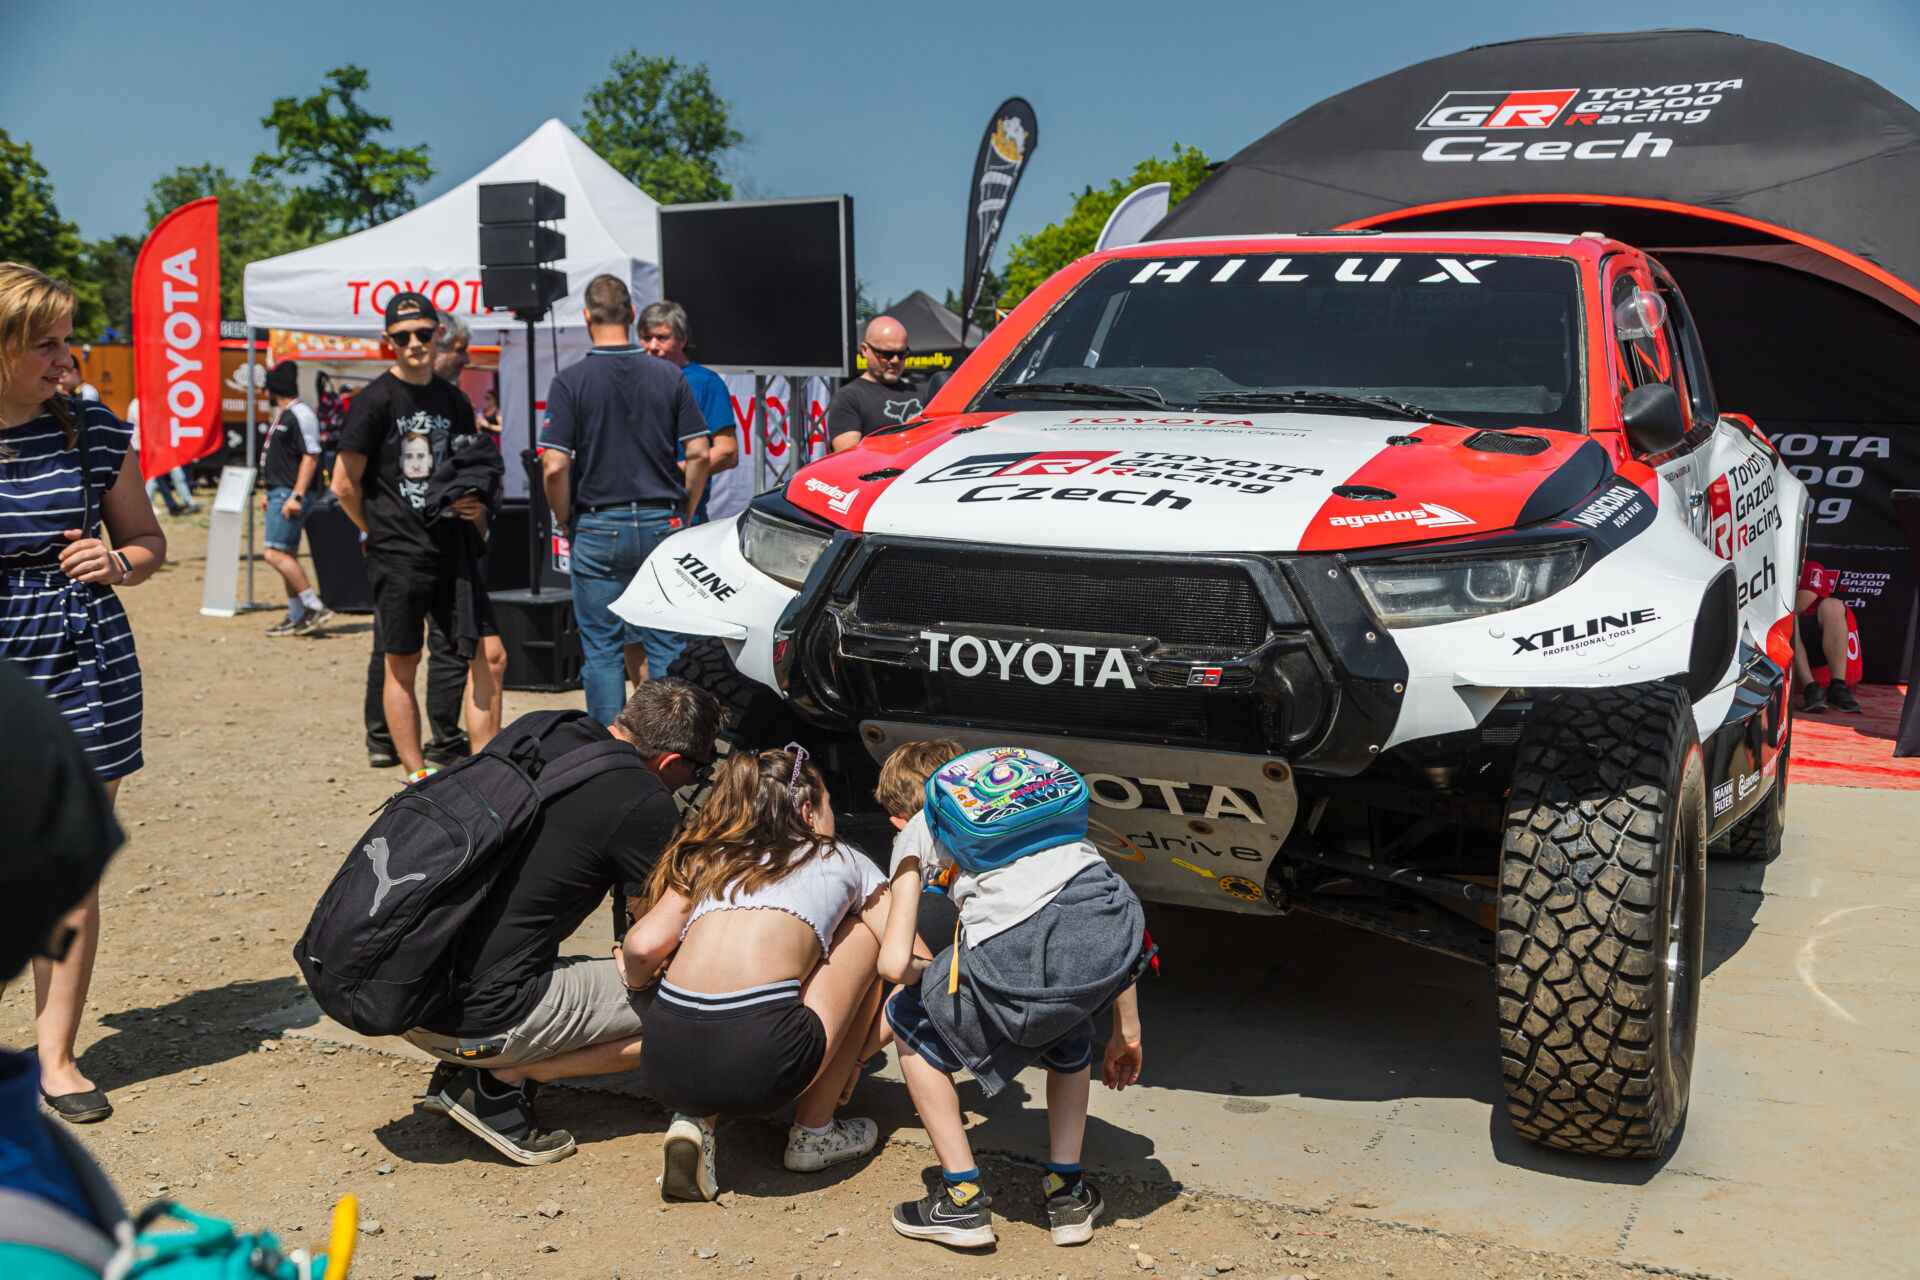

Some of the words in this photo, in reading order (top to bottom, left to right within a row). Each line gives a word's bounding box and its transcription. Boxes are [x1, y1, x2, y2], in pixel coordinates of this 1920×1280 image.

[1587, 78, 1743, 100] TOYOTA
[1427, 104, 1561, 127] GR
[1574, 94, 1723, 113] GAZOO
[1564, 108, 1711, 126] Racing
[1421, 132, 1673, 162] Czech
[1129, 258, 1497, 284] HILUX
[347, 279, 517, 315] TOOT
[162, 247, 204, 448] TOYOTA
[1068, 418, 1254, 427] TOYOTA
[1247, 430, 1307, 438] CZECH
[1768, 433, 1890, 459] OTA
[917, 457, 1093, 484] GR
[1114, 459, 1294, 484] GAZOO
[1134, 451, 1325, 477] TOYOTA
[1729, 452, 1769, 492] TOYOTA
[805, 477, 848, 500] agados
[1091, 466, 1275, 494] Racing
[957, 483, 1193, 511] Czech
[1573, 485, 1639, 528] MUSICDATA
[1736, 475, 1775, 522] GAZOO
[1329, 509, 1428, 528] agados
[1612, 513, 1630, 528] PLUG
[1627, 501, 1644, 516] PLAY
[1737, 503, 1783, 552] Racing
[1737, 555, 1776, 611] ech
[1840, 578, 1885, 587] GAZOO
[1842, 571, 1891, 580] TOYOTA
[1838, 585, 1882, 596] Racing
[1543, 636, 1606, 657] PROFESSIONAL
[1609, 628, 1636, 640] TOOLS
[920, 631, 1136, 689] TOYOTA
[1190, 673, 1218, 684] GR
[1083, 773, 1266, 824] OTA
[1714, 782, 1733, 801] MANN
[1715, 794, 1733, 814] FILTER
